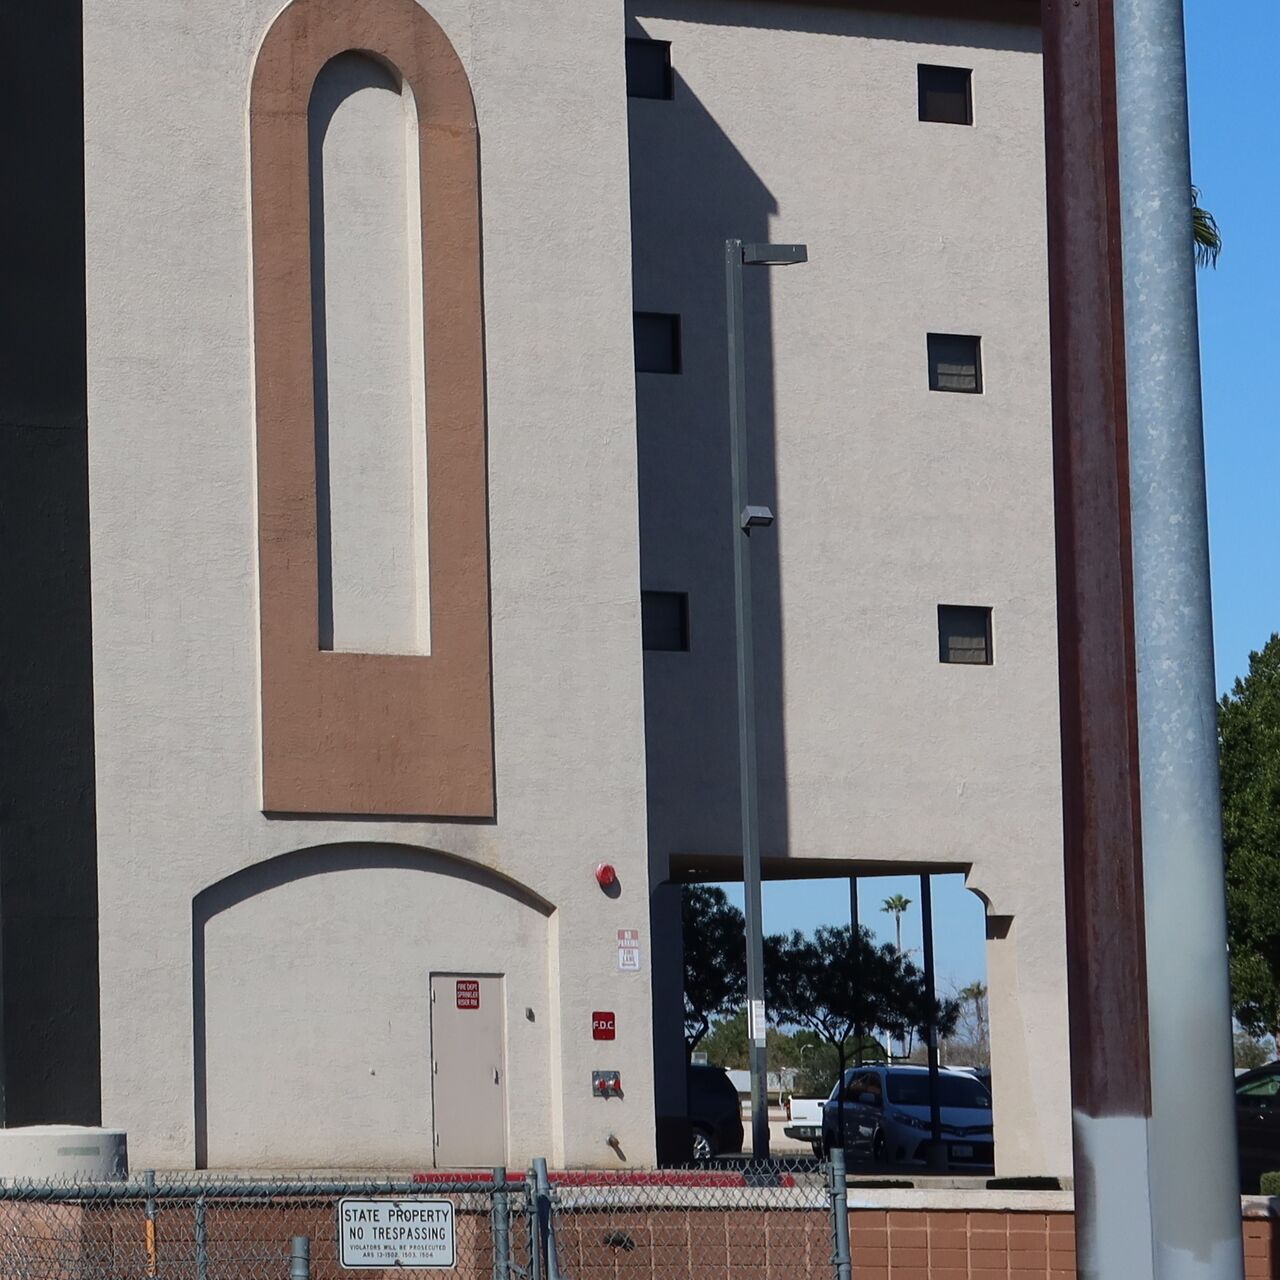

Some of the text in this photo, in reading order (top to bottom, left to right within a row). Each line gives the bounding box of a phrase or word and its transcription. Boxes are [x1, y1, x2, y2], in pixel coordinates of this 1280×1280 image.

[344, 1209, 449, 1223] STATE PROPERTY
[349, 1227, 446, 1241] NO TRESPASSING
